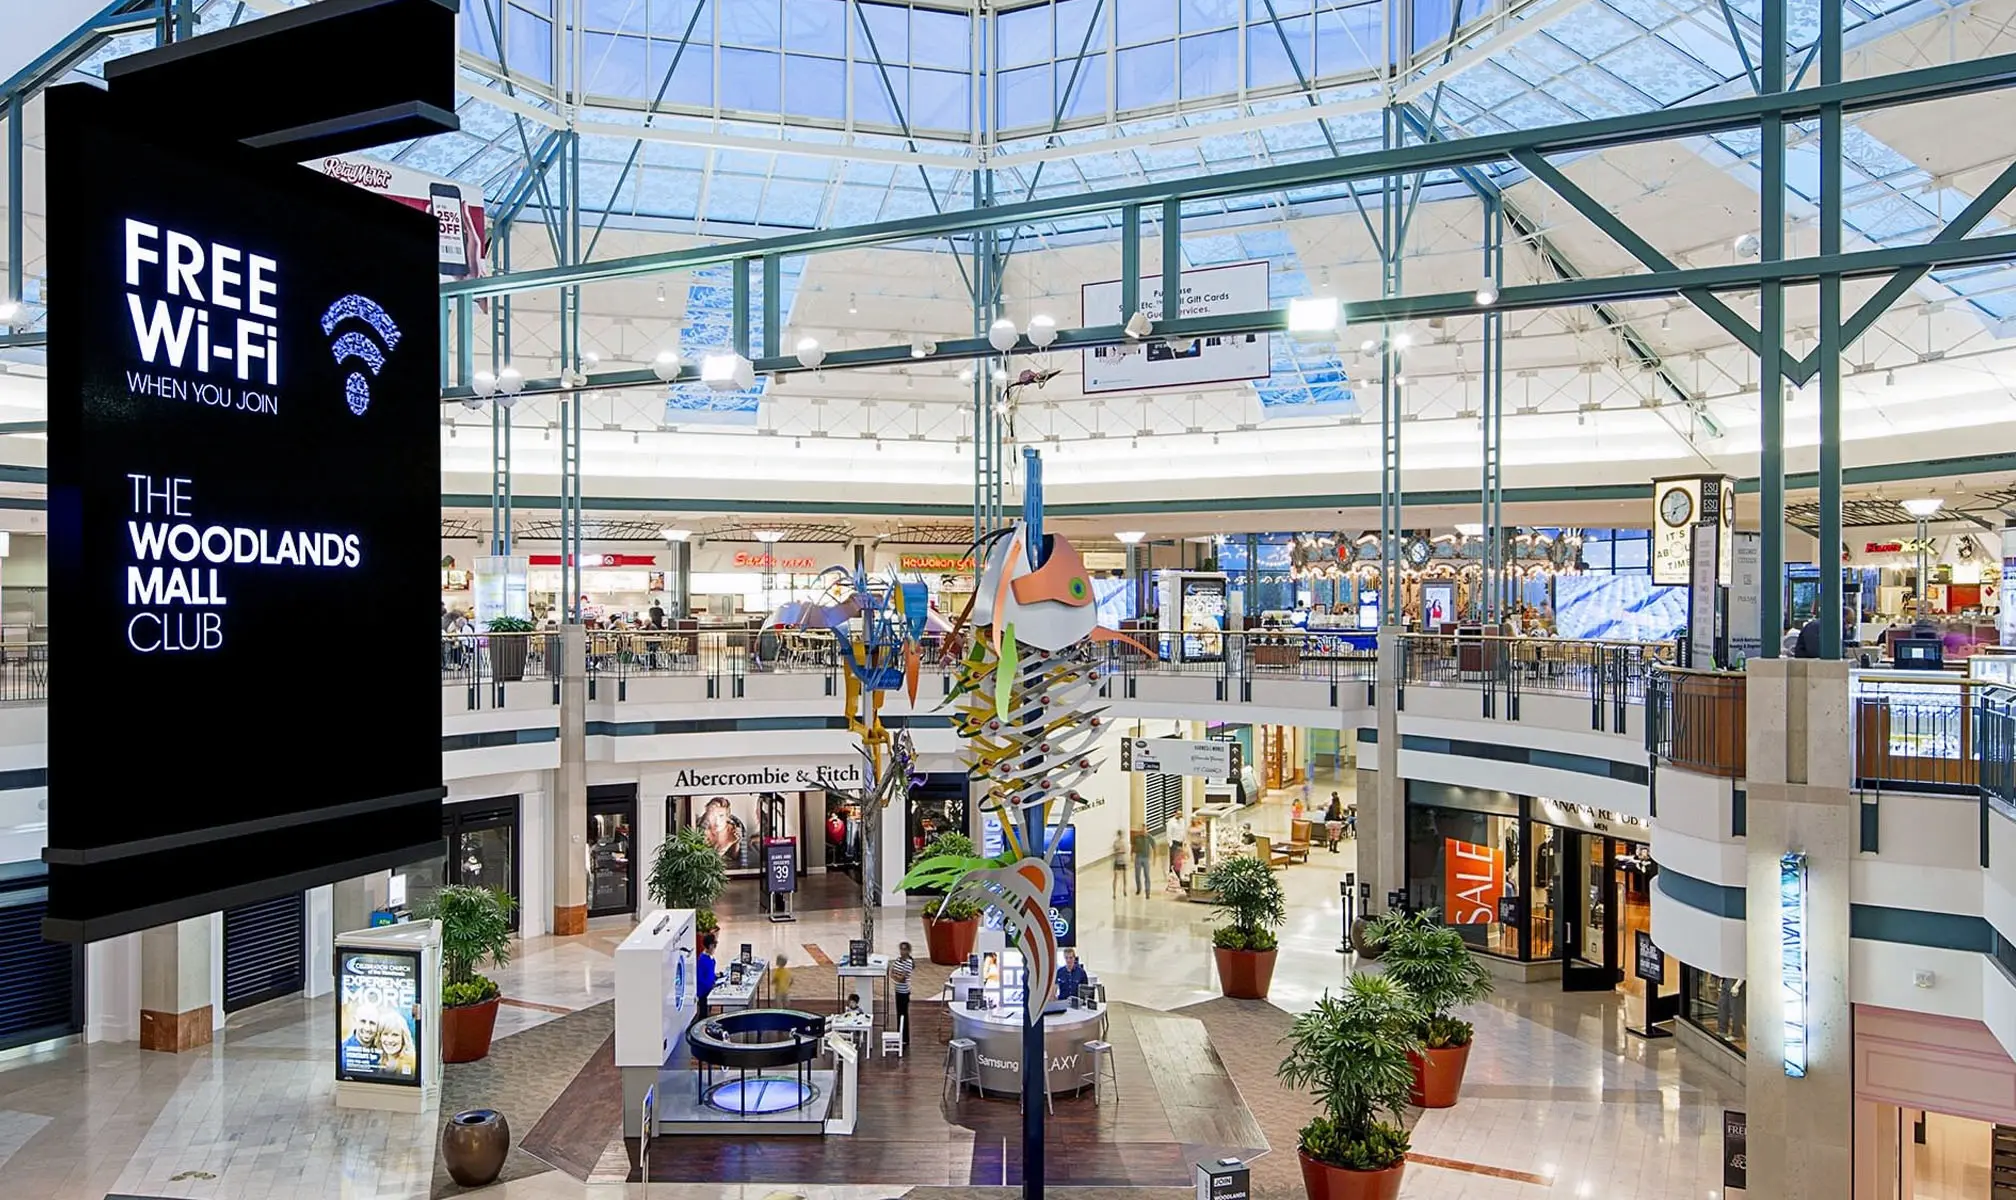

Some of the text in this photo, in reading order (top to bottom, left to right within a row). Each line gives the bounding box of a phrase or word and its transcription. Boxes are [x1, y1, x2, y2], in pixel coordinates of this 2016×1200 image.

[324, 157, 392, 189] RetailMeNot
[436, 210, 460, 224] 25%
[439, 222, 461, 236] OFF
[126, 218, 277, 319] FREE
[1187, 295, 1202, 305] Gift
[1203, 291, 1230, 303] Cards
[126, 292, 277, 385] Wi-Fi
[126, 370, 278, 415] WHEN YOU JOIN
[127, 473, 192, 517] THE
[127, 520, 361, 568] WOODLANDS
[127, 565, 227, 605] MALL
[127, 612, 223, 652] CLUB
[675, 764, 860, 788] Abercrombie & Fitch
[1594, 822, 1608, 832] MEN
[773, 865, 789, 879] $39
[1456, 840, 1494, 924] SALE
[343, 975, 415, 990] EXPERIENCE
[343, 985, 416, 1009] MORE
[978, 1054, 1019, 1072] Samsung
[1214, 1177, 1232, 1186] JOIN
